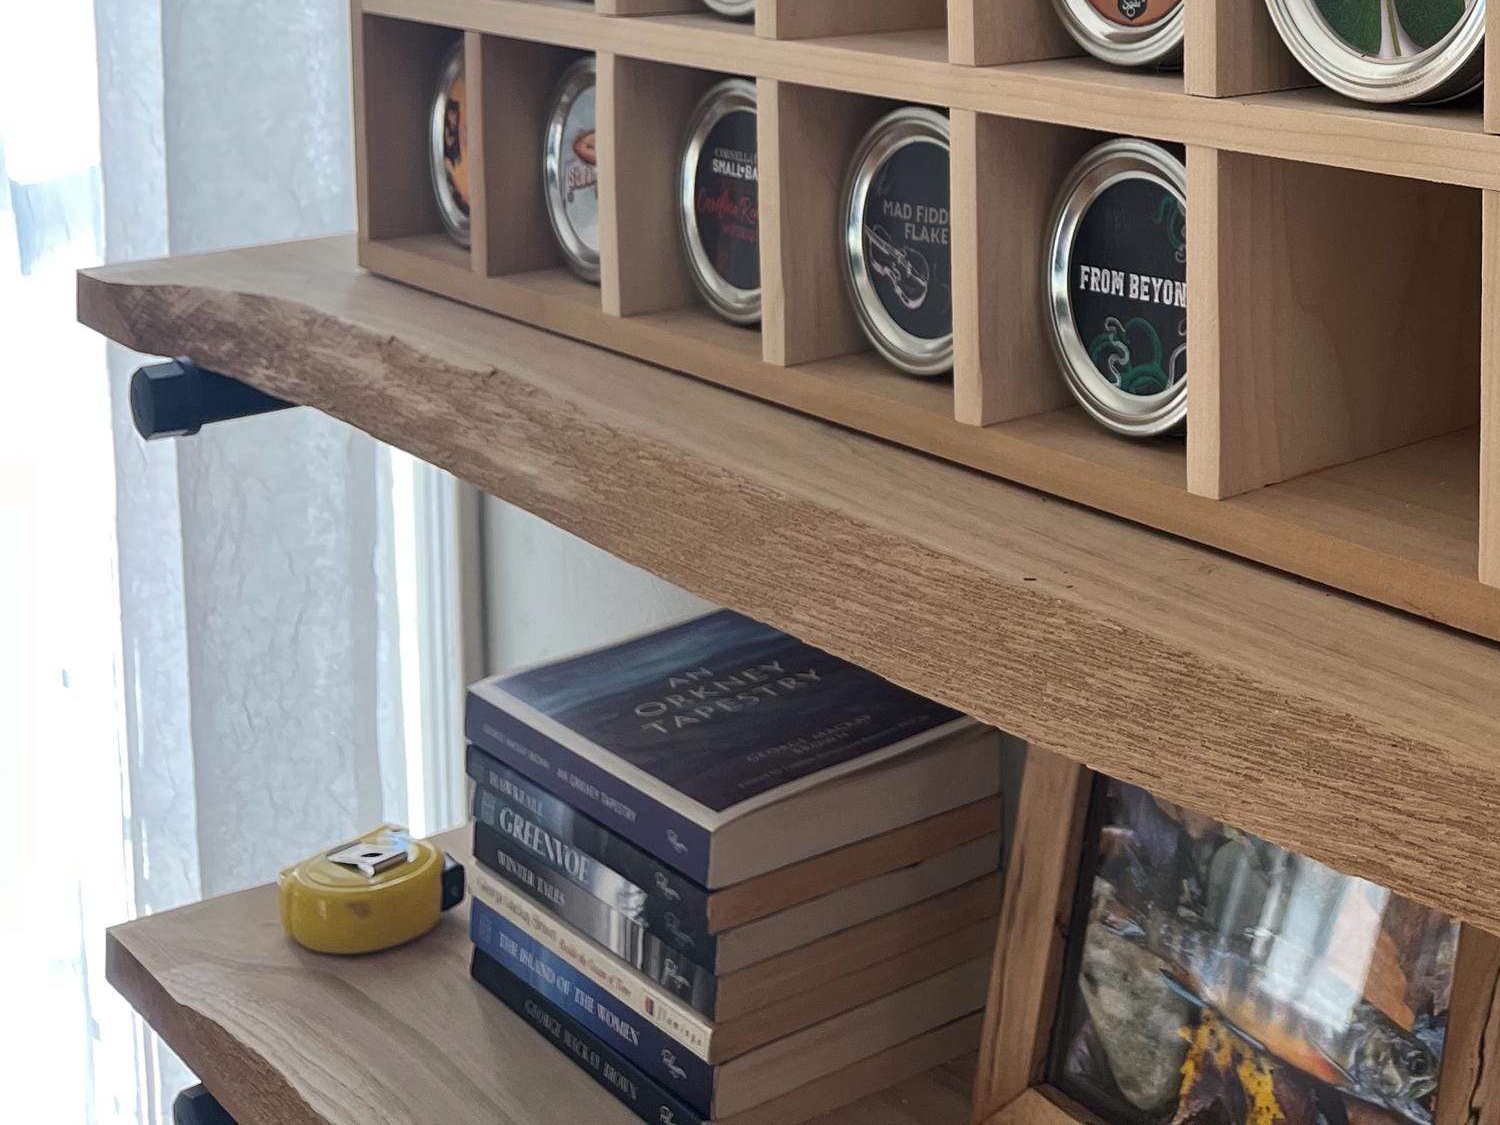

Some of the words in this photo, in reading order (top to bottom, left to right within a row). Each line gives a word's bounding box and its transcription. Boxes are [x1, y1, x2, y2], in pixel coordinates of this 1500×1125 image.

[882, 199, 912, 219] MAD
[904, 222, 949, 245] FLAKE
[1079, 264, 1125, 298] FROM
[634, 659, 785, 717] ORKNEY
[668, 667, 714, 689] AN
[640, 668, 822, 734] TAPESTRY
[574, 986, 595, 1015] THE
[597, 1002, 640, 1047] WOMEN
